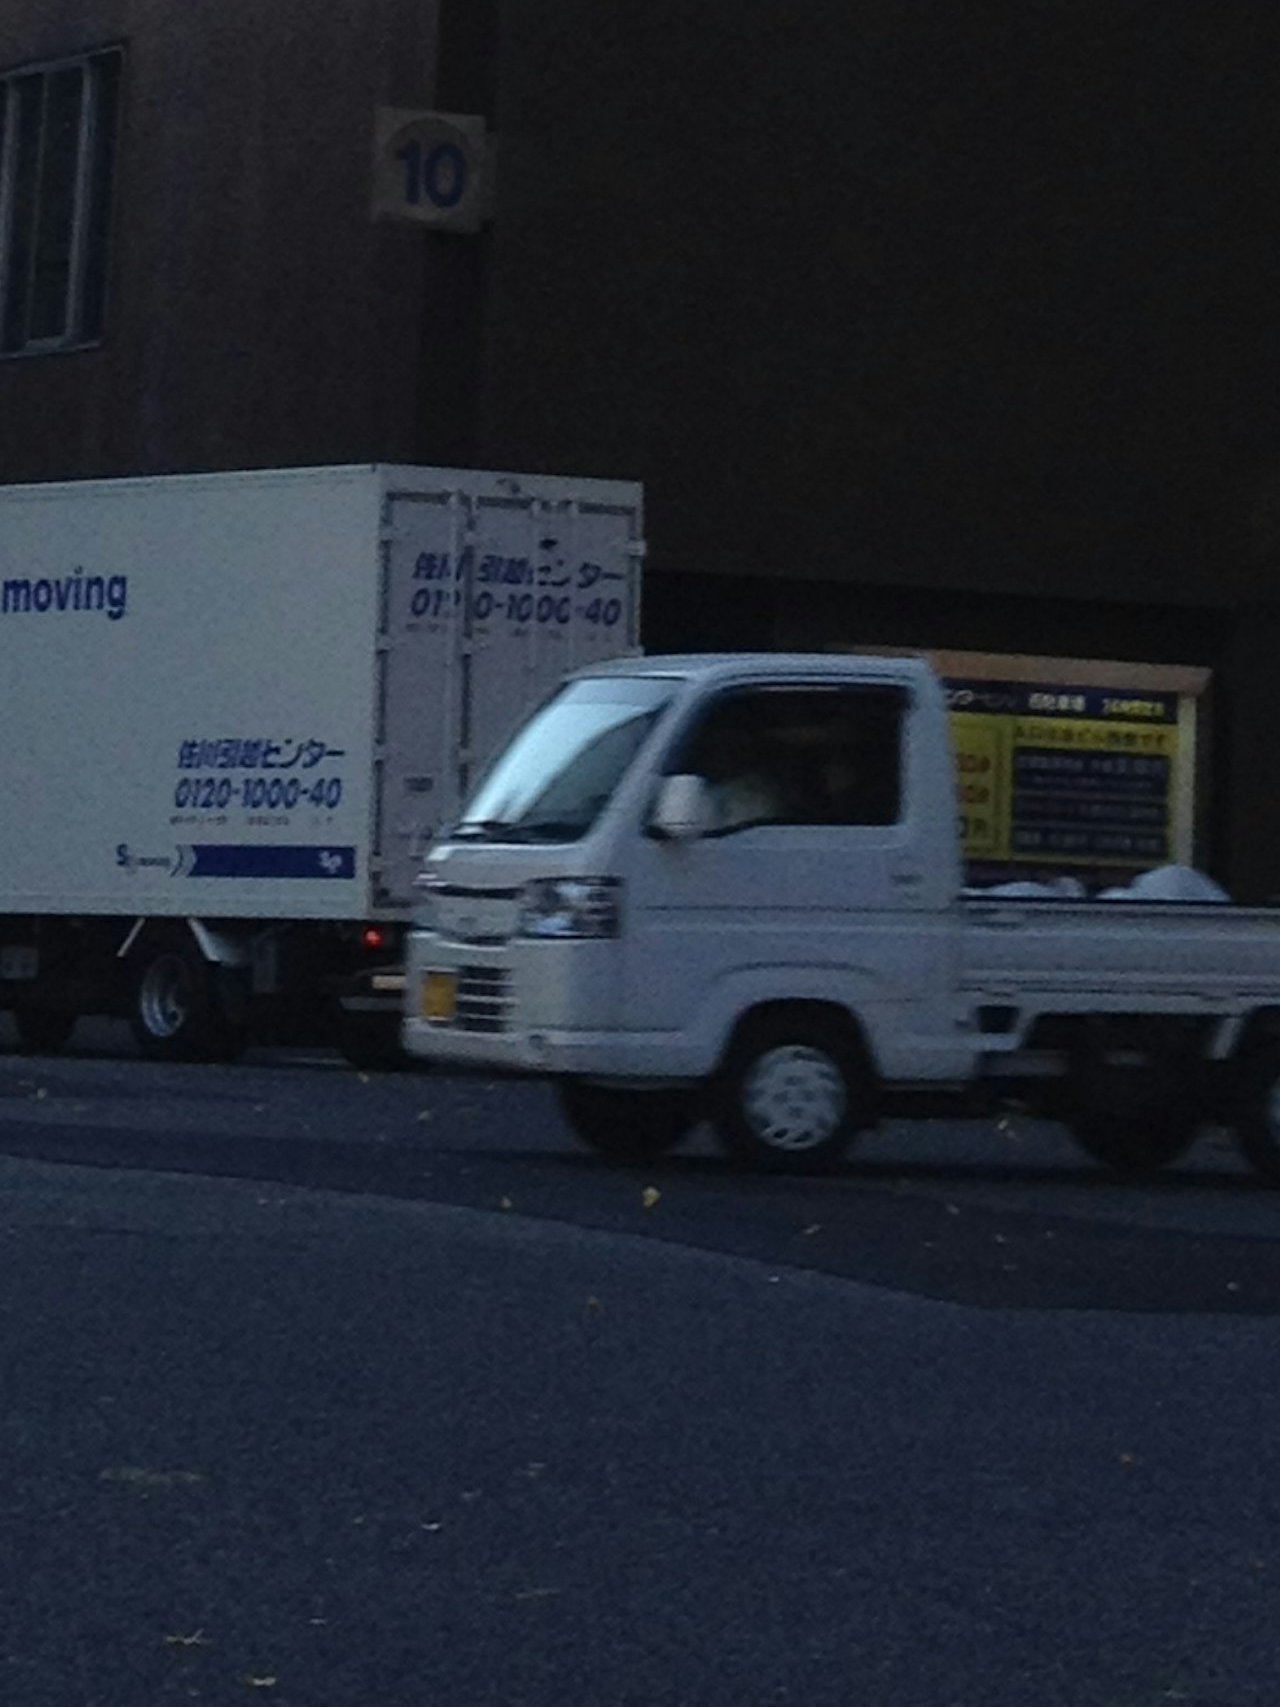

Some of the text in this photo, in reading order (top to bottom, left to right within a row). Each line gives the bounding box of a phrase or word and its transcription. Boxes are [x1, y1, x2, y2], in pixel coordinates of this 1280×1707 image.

[395, 139, 466, 208] 10
[2, 566, 128, 620] moving
[175, 777, 342, 809] 0120-1000-40
